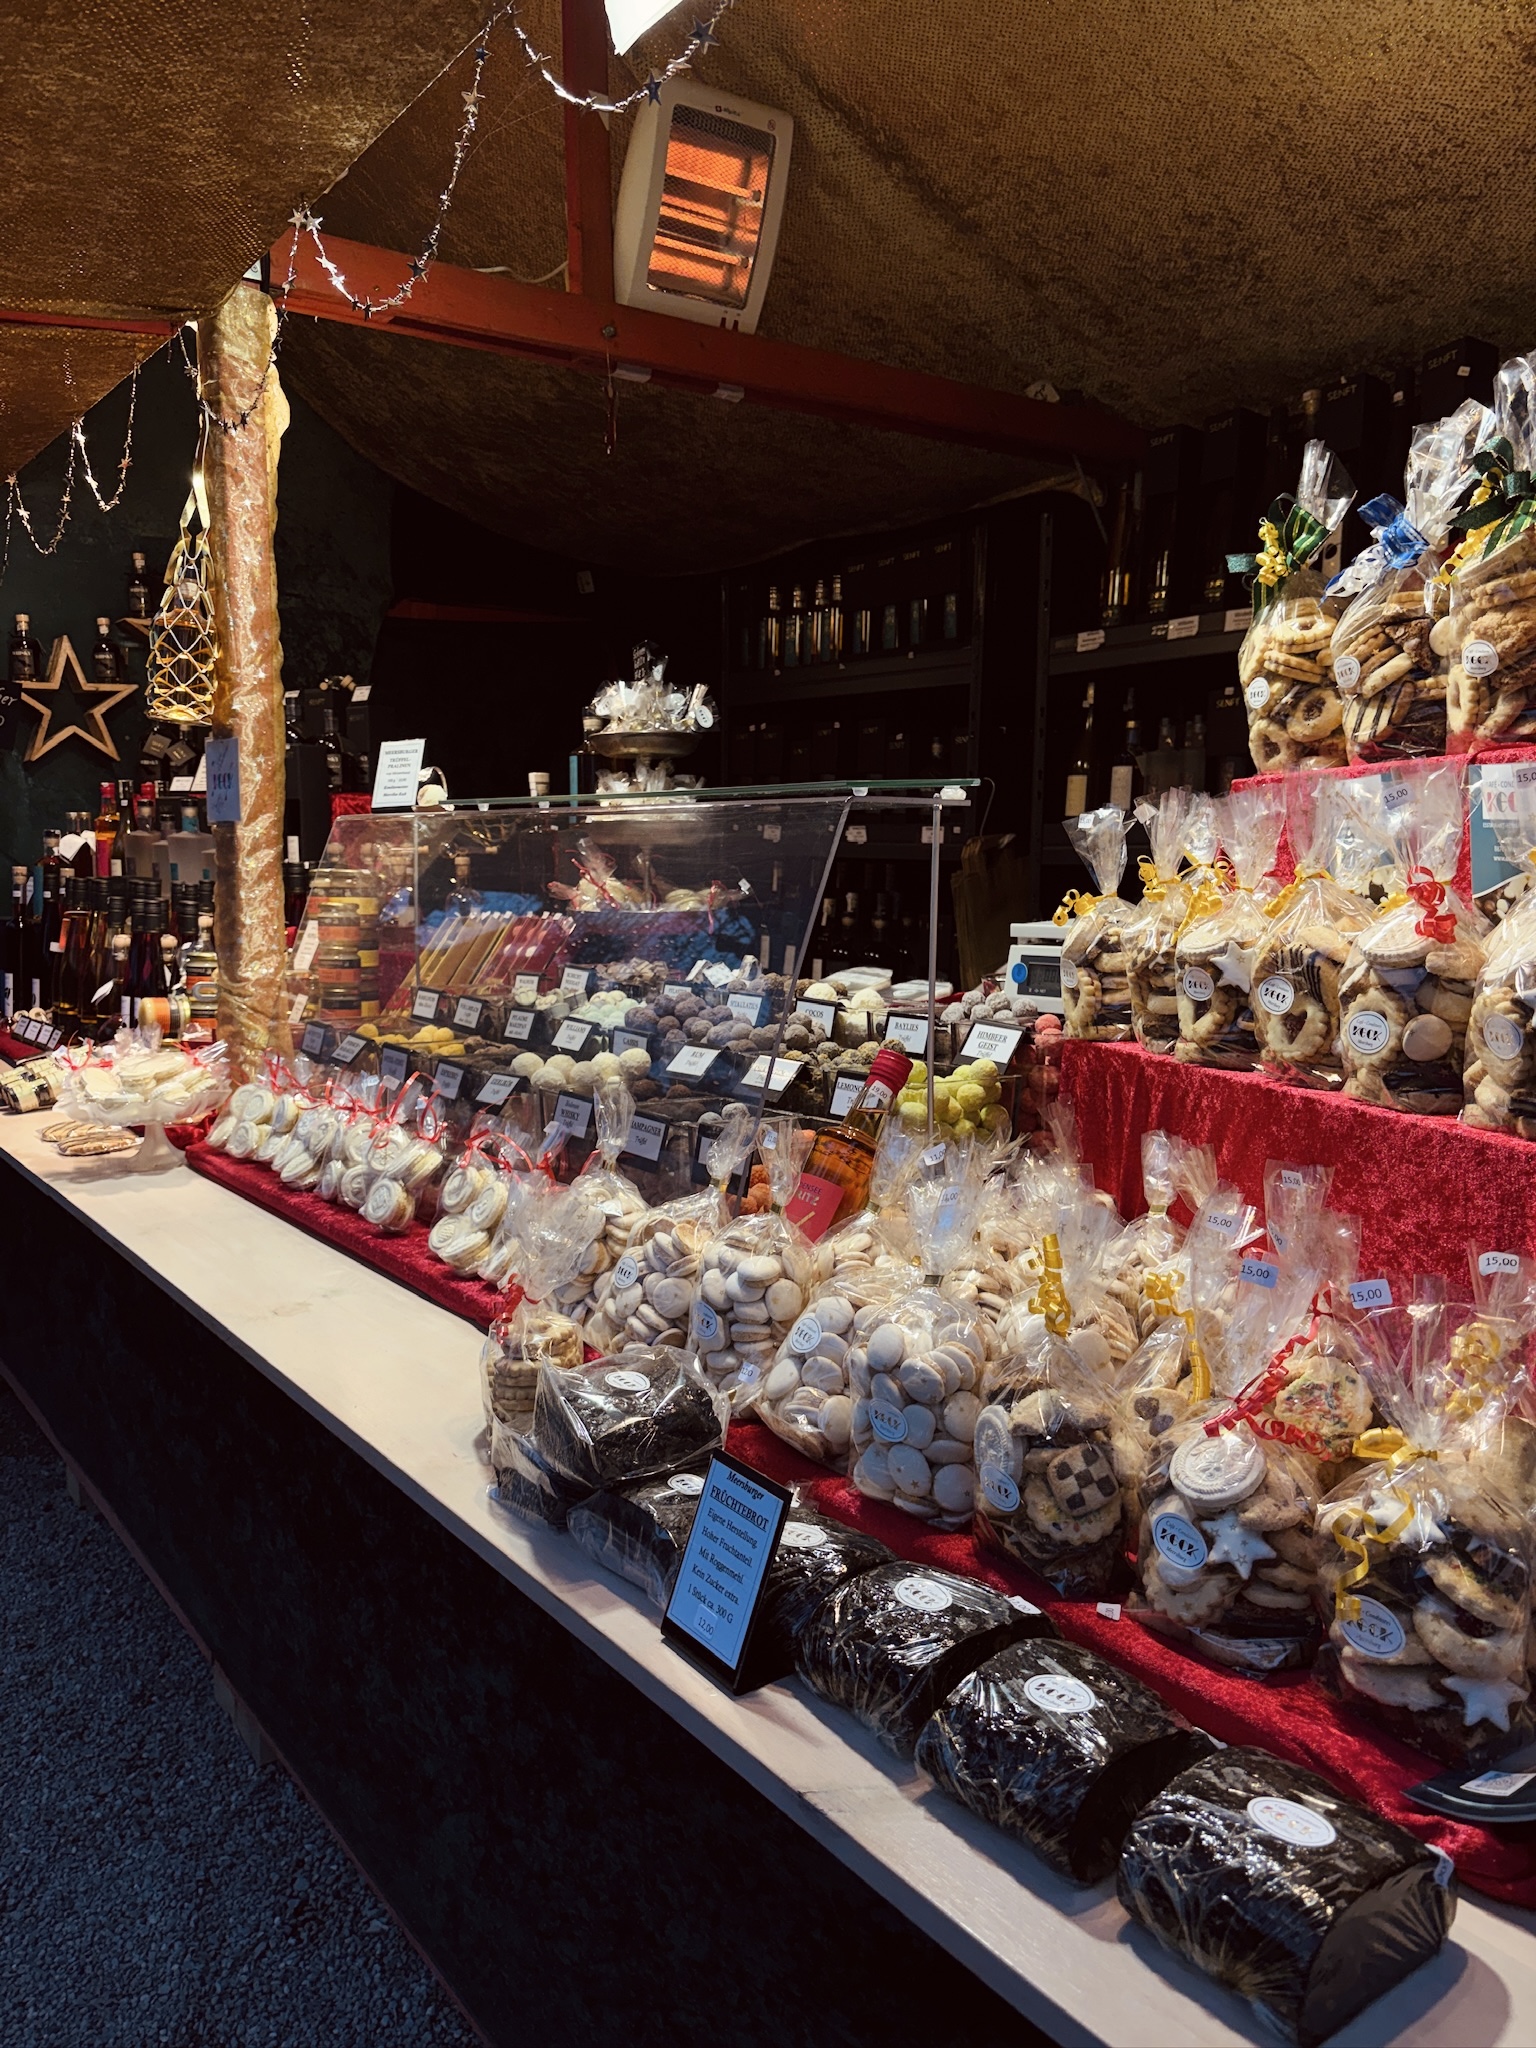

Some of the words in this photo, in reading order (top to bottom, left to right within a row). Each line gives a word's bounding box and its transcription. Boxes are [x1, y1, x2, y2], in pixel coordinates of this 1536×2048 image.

[1428, 350, 1458, 370] SENFT
[1327, 384, 1357, 402] SENFT
[1384, 788, 1408, 804] 15,00
[1486, 792, 1518, 812] KEC
[1264, 987, 1289, 1005] KECK
[894, 1021, 919, 1032] BAYLIES
[1352, 1026, 1383, 1042] KECK
[976, 1030, 1008, 1044] HIMBEER
[690, 1050, 705, 1058] RUM
[977, 1041, 999, 1051] GEIST
[871, 1085, 887, 1099] 19,00
[560, 1108, 579, 1121] WHISKY
[930, 1150, 946, 1162] 11,00
[1283, 1176, 1301, 1186] 15,00
[1207, 1215, 1232, 1228] 15,00
[1485, 1256, 1518, 1267] 15,00
[1240, 1264, 1270, 1279] 15,00
[1351, 1288, 1382, 1303] 15,00
[727, 1470, 765, 1501] Meersburger
[710, 1485, 770, 1530] FRÜCHTEBROT
[707, 1508, 726, 1529] Eigene
[702, 1526, 718, 1544] Hoher
[1160, 1527, 1199, 1560] KECK
[700, 1547, 709, 1561] Mit
[691, 1563, 705, 1579] Kein
[705, 1574, 724, 1595] Zucker
[692, 1586, 706, 1605] Stück
[706, 1599, 715, 1611] ca.
[715, 1604, 727, 1620] 300
[726, 1612, 734, 1624] G
[698, 1617, 714, 1636] 12,00
[1034, 1682, 1083, 1708] KECK
[1260, 1805, 1319, 1838] KECK
